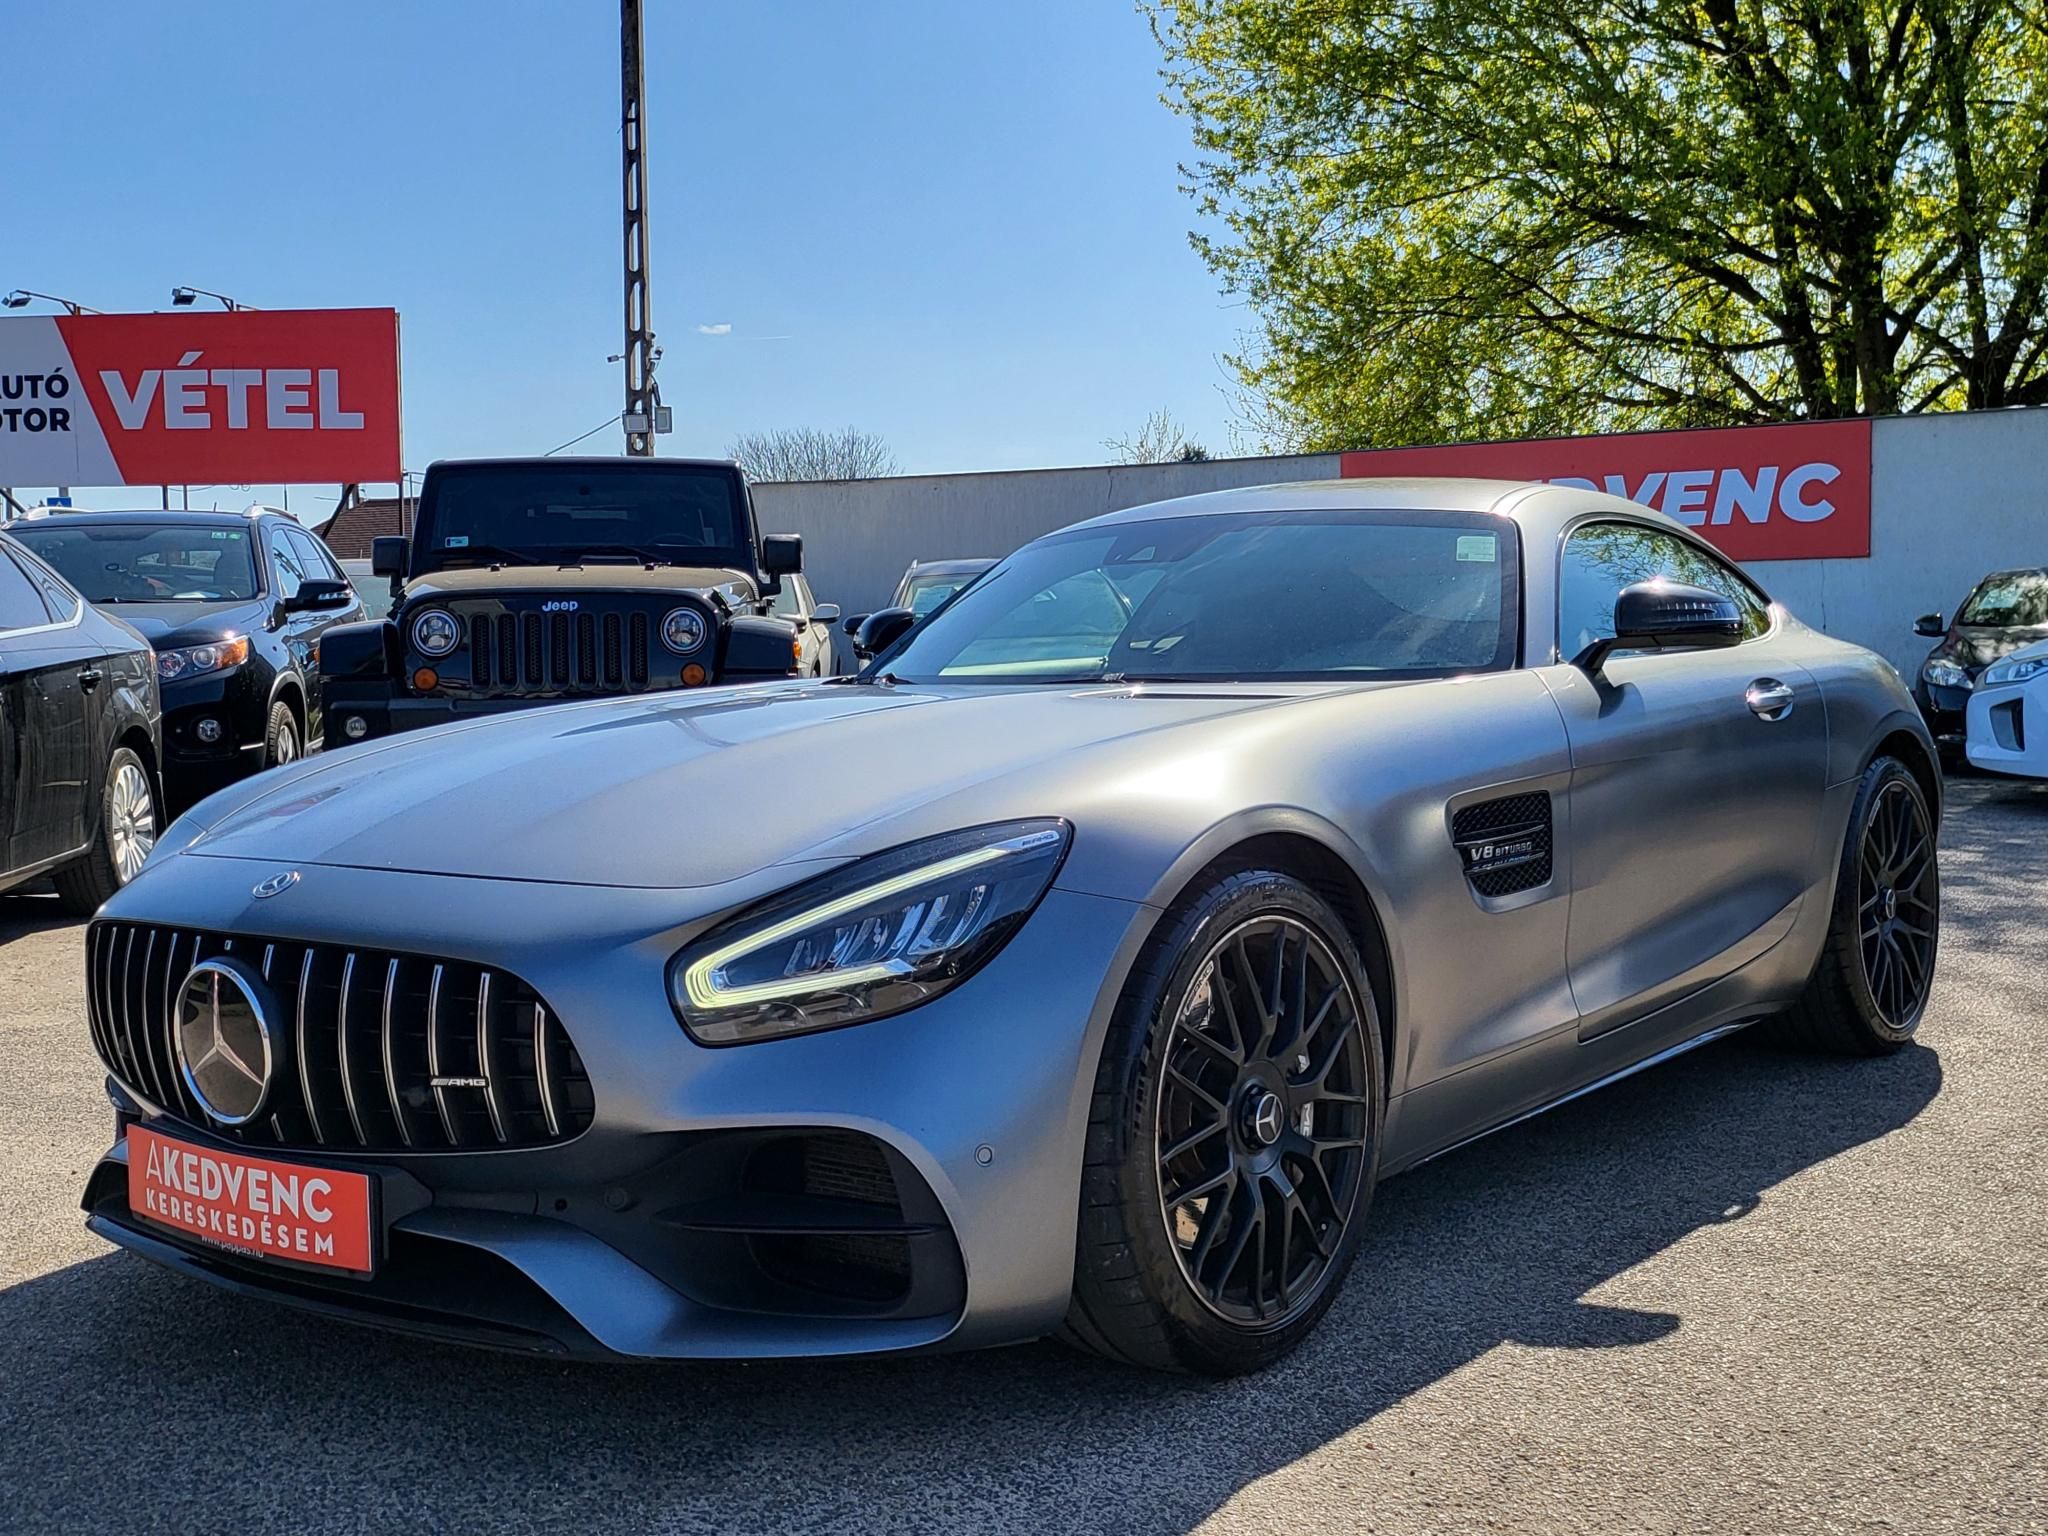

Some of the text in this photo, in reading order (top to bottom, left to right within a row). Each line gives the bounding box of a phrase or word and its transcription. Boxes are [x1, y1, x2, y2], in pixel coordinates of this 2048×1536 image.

[0, 366, 69, 399] UTÓ
[99, 351, 365, 430] VÉTEL
[0, 407, 71, 432] TOR
[541, 600, 579, 612] Jeep
[1471, 841, 1532, 861] V8 BITURBO
[446, 1078, 486, 1087] AMG
[145, 1187, 335, 1258] KERESKEDÉSEM
